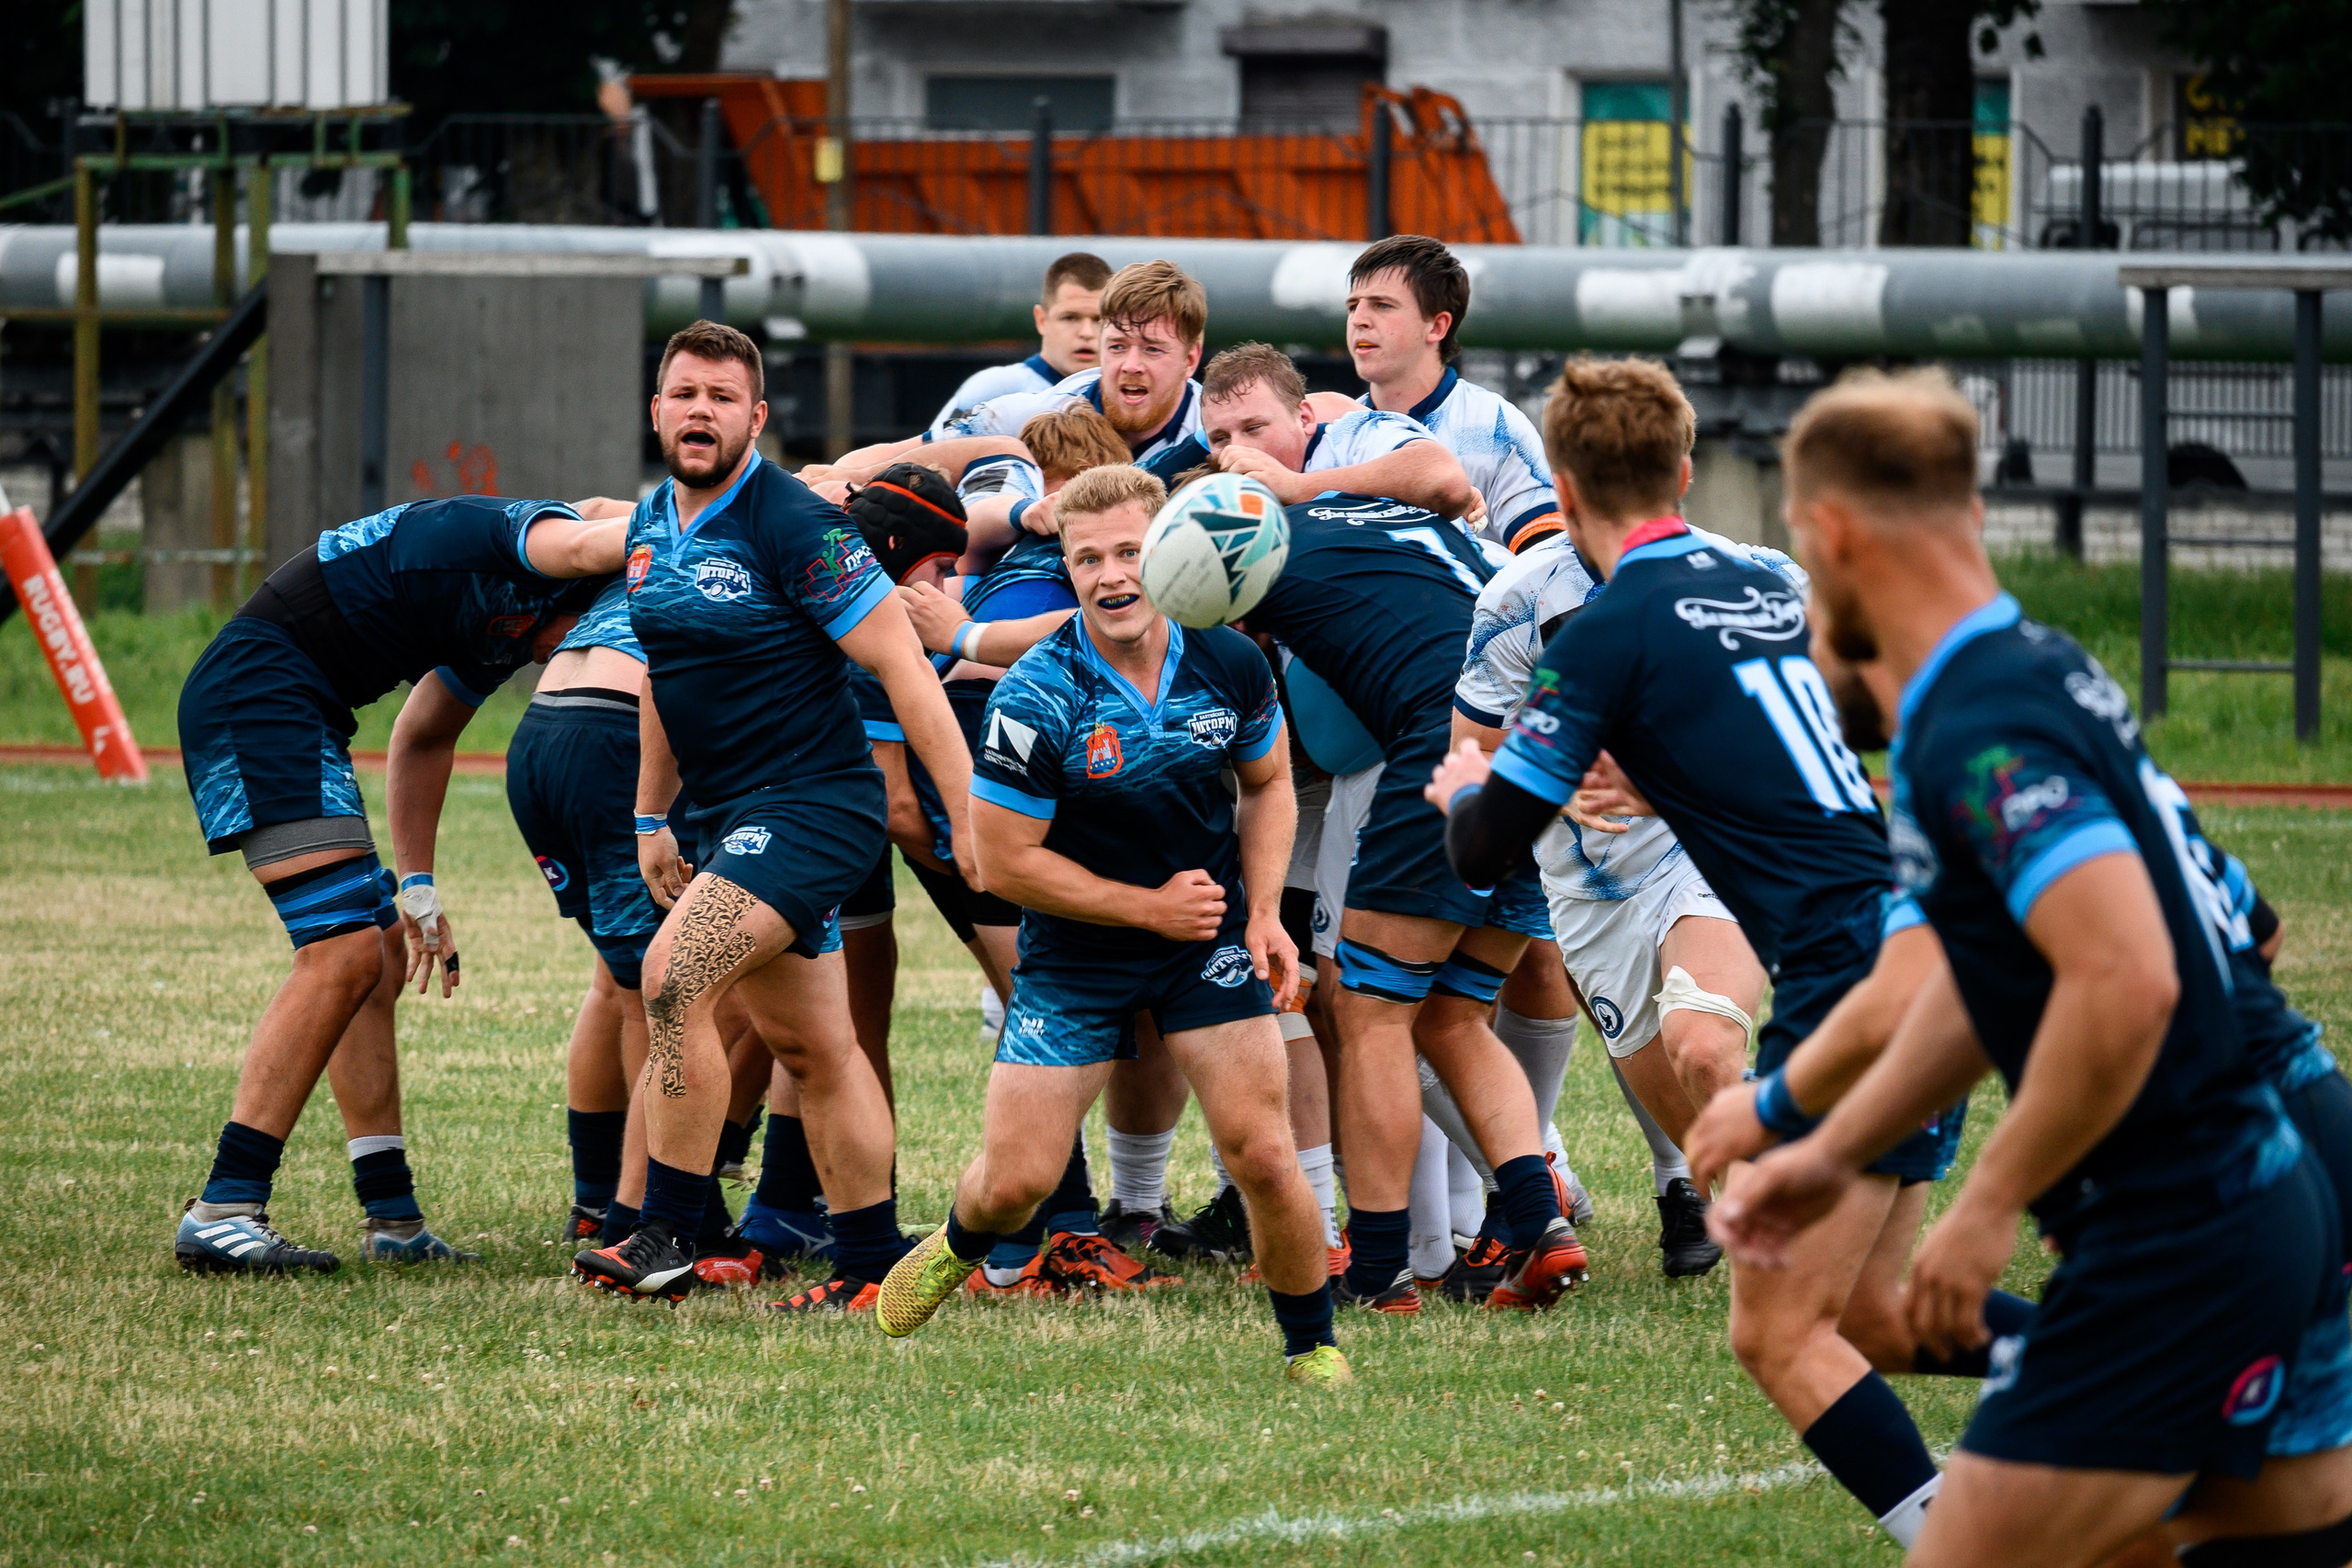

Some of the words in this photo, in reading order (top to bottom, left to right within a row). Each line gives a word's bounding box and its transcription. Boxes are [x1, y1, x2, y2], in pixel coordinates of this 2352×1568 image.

[22, 573, 96, 705] RUGBY.RU
[1192, 716, 1234, 737] ШТОРМ
[721, 831, 767, 849] ТОРМ
